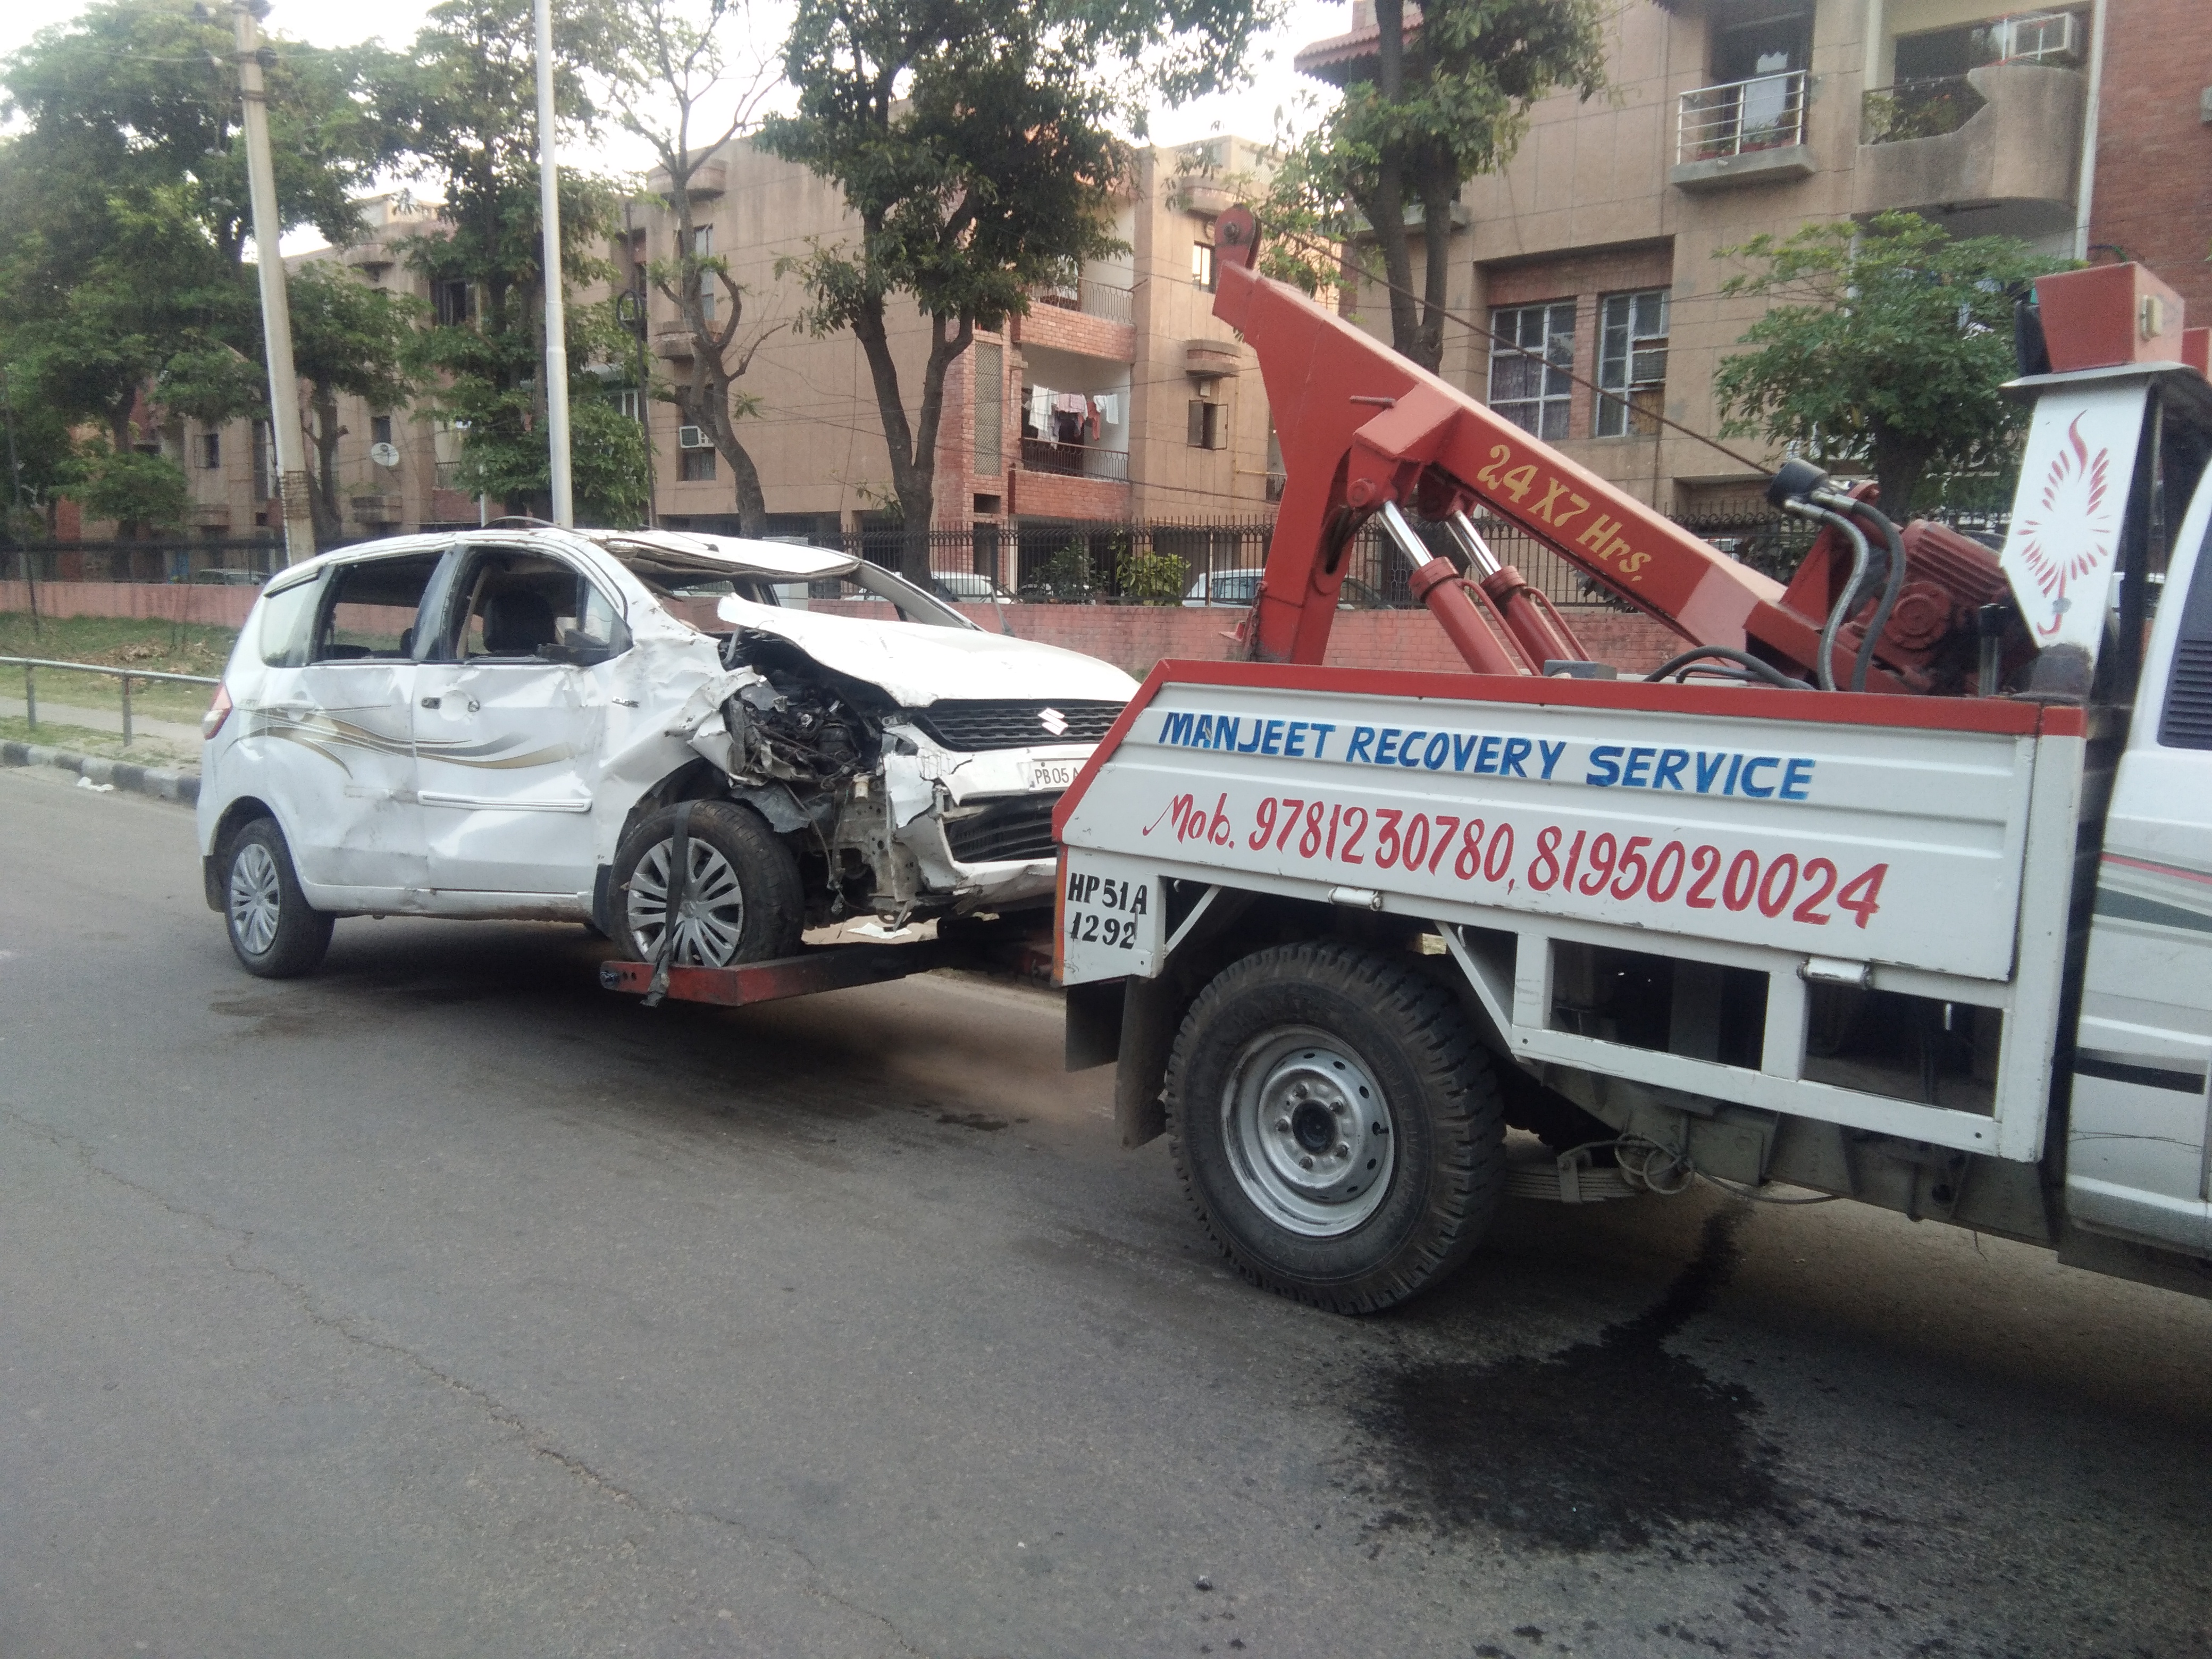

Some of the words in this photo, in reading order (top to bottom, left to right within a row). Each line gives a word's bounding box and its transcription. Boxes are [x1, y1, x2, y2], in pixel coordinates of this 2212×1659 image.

[1576, 514, 1652, 582] Hrs.
[1158, 711, 1336, 759] MANJEET
[1345, 726, 1566, 780] RECOVERY
[1586, 745, 1816, 800] SERVICE
[1143, 793, 1235, 850] Mob.
[1528, 826, 1889, 929] 8195020024
[1069, 911, 1137, 950] 1292
